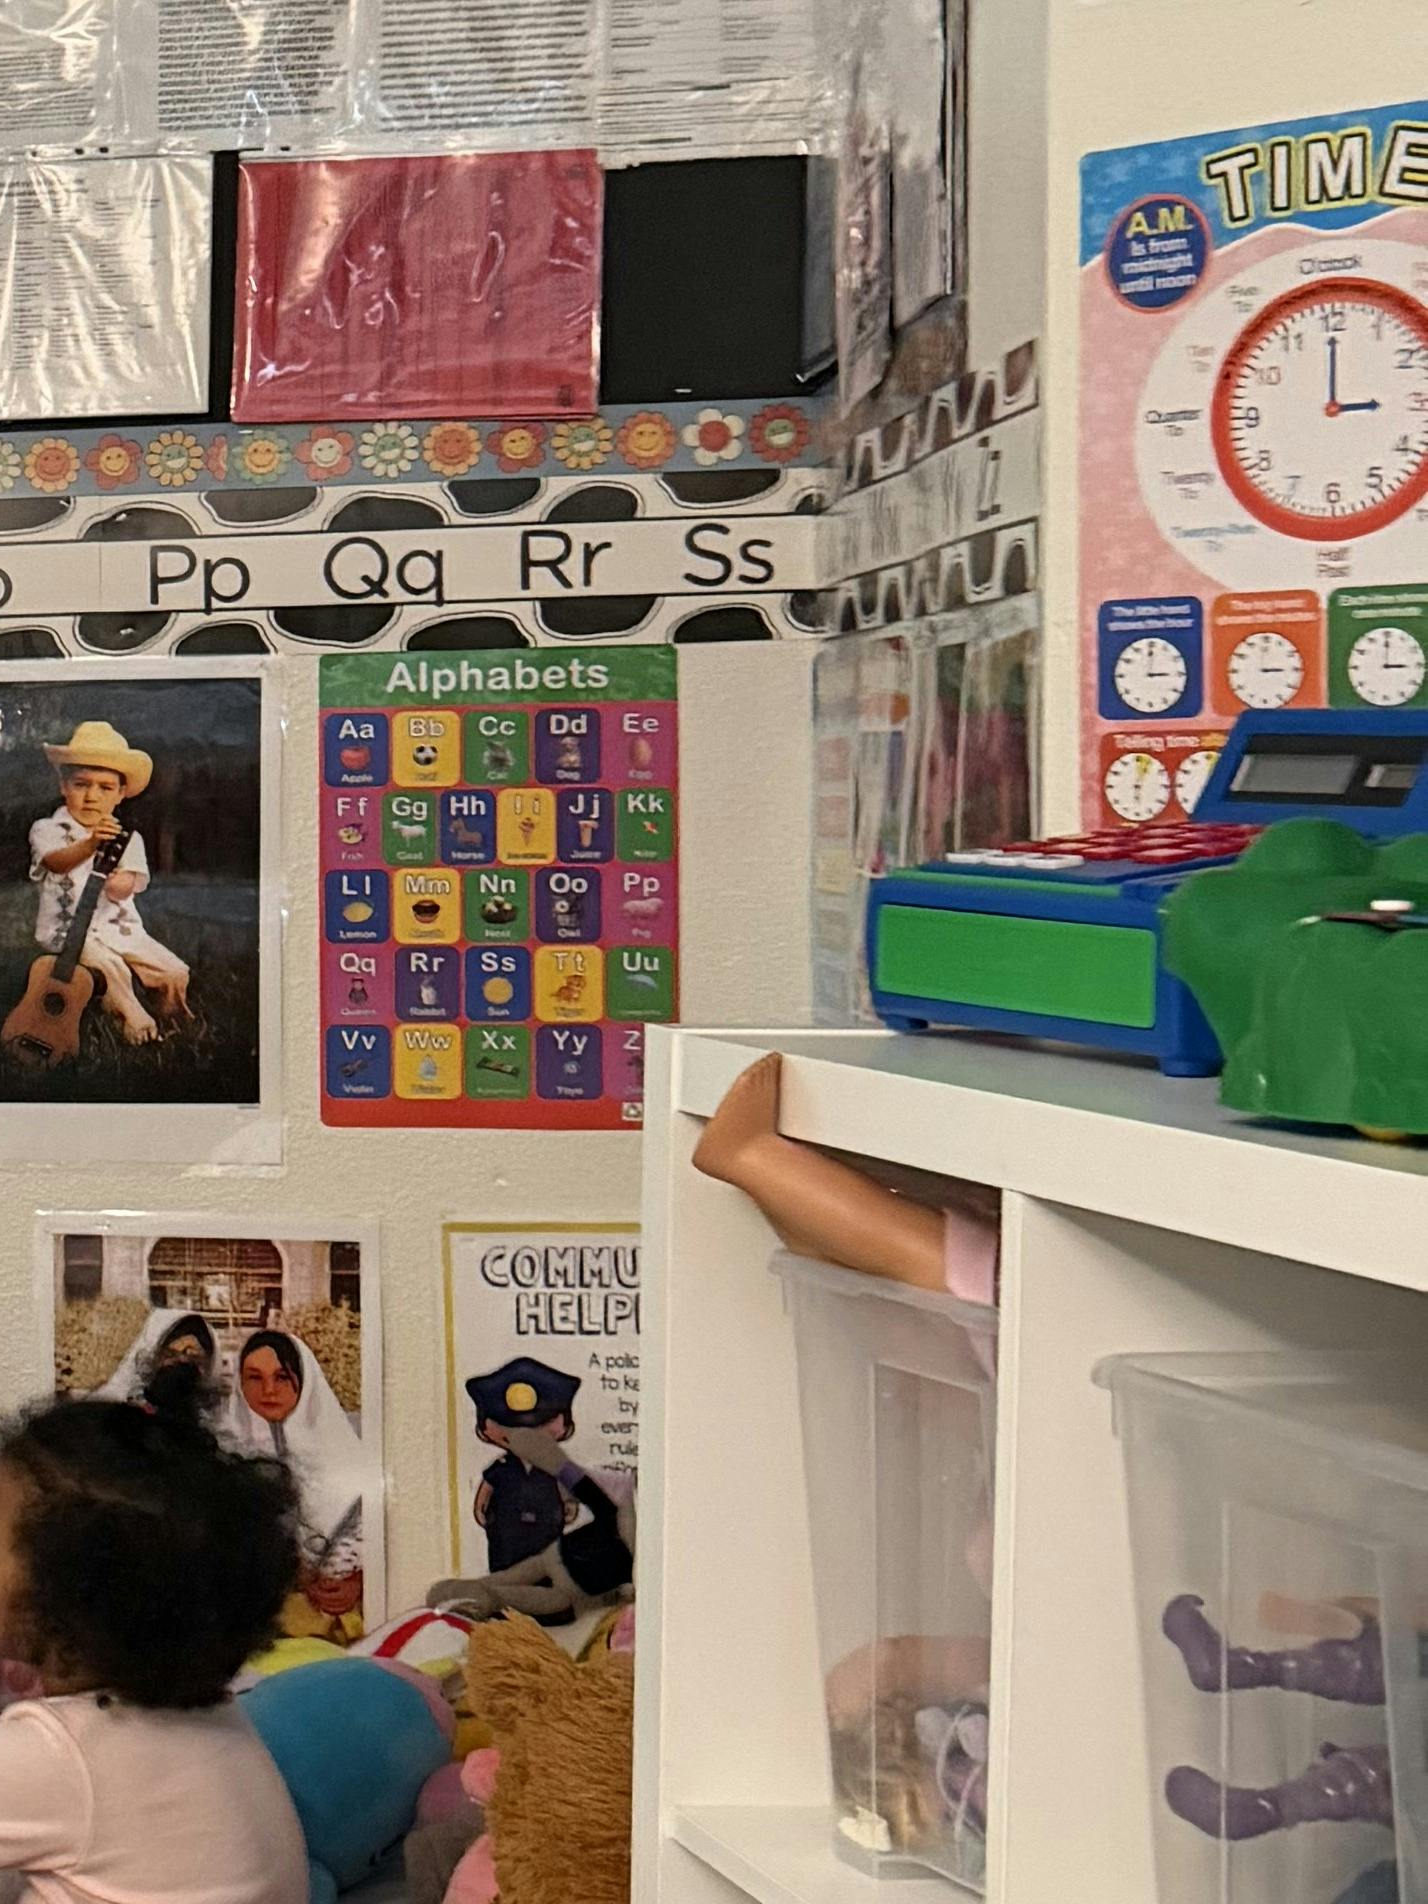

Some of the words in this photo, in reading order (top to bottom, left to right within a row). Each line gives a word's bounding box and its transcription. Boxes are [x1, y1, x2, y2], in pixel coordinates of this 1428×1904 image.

[1200, 120, 1428, 229] TIME
[1126, 205, 1194, 238] A.M.
[1321, 310, 1346, 333] 12
[1246, 407, 1260, 428] 9
[1258, 450, 1271, 472] 8
[1367, 466, 1383, 489] 5
[1326, 482, 1341, 503] 6
[149, 544, 250, 616] Pp
[323, 536, 444, 607] Qq
[519, 529, 612, 592] Rr
[683, 521, 776, 588] Ss
[386, 659, 610, 697] Alphabets
[339, 720, 375, 739] Aa
[408, 718, 444, 737] Bb
[478, 716, 516, 736] Cc
[550, 714, 587, 734] Dd
[622, 713, 660, 733] Ee
[391, 797, 428, 820] Gg
[449, 796, 487, 815] Hh
[628, 794, 664, 813] Kk
[404, 875, 450, 894] Mm
[479, 875, 516, 894] Nn
[549, 873, 588, 894] Oo
[623, 873, 660, 896] Pp
[339, 953, 376, 976] Qq
[410, 952, 446, 973] Rr
[481, 953, 516, 972] Ss
[622, 952, 660, 972] Uu
[341, 1030, 377, 1051] Vv
[404, 1031, 452, 1050] Ww
[481, 1030, 516, 1051] Xx
[552, 1030, 588, 1055] Yy
[516, 1292, 641, 1335] HELP
[589, 1353, 601, 1368] A
[600, 1374, 619, 1390] to
